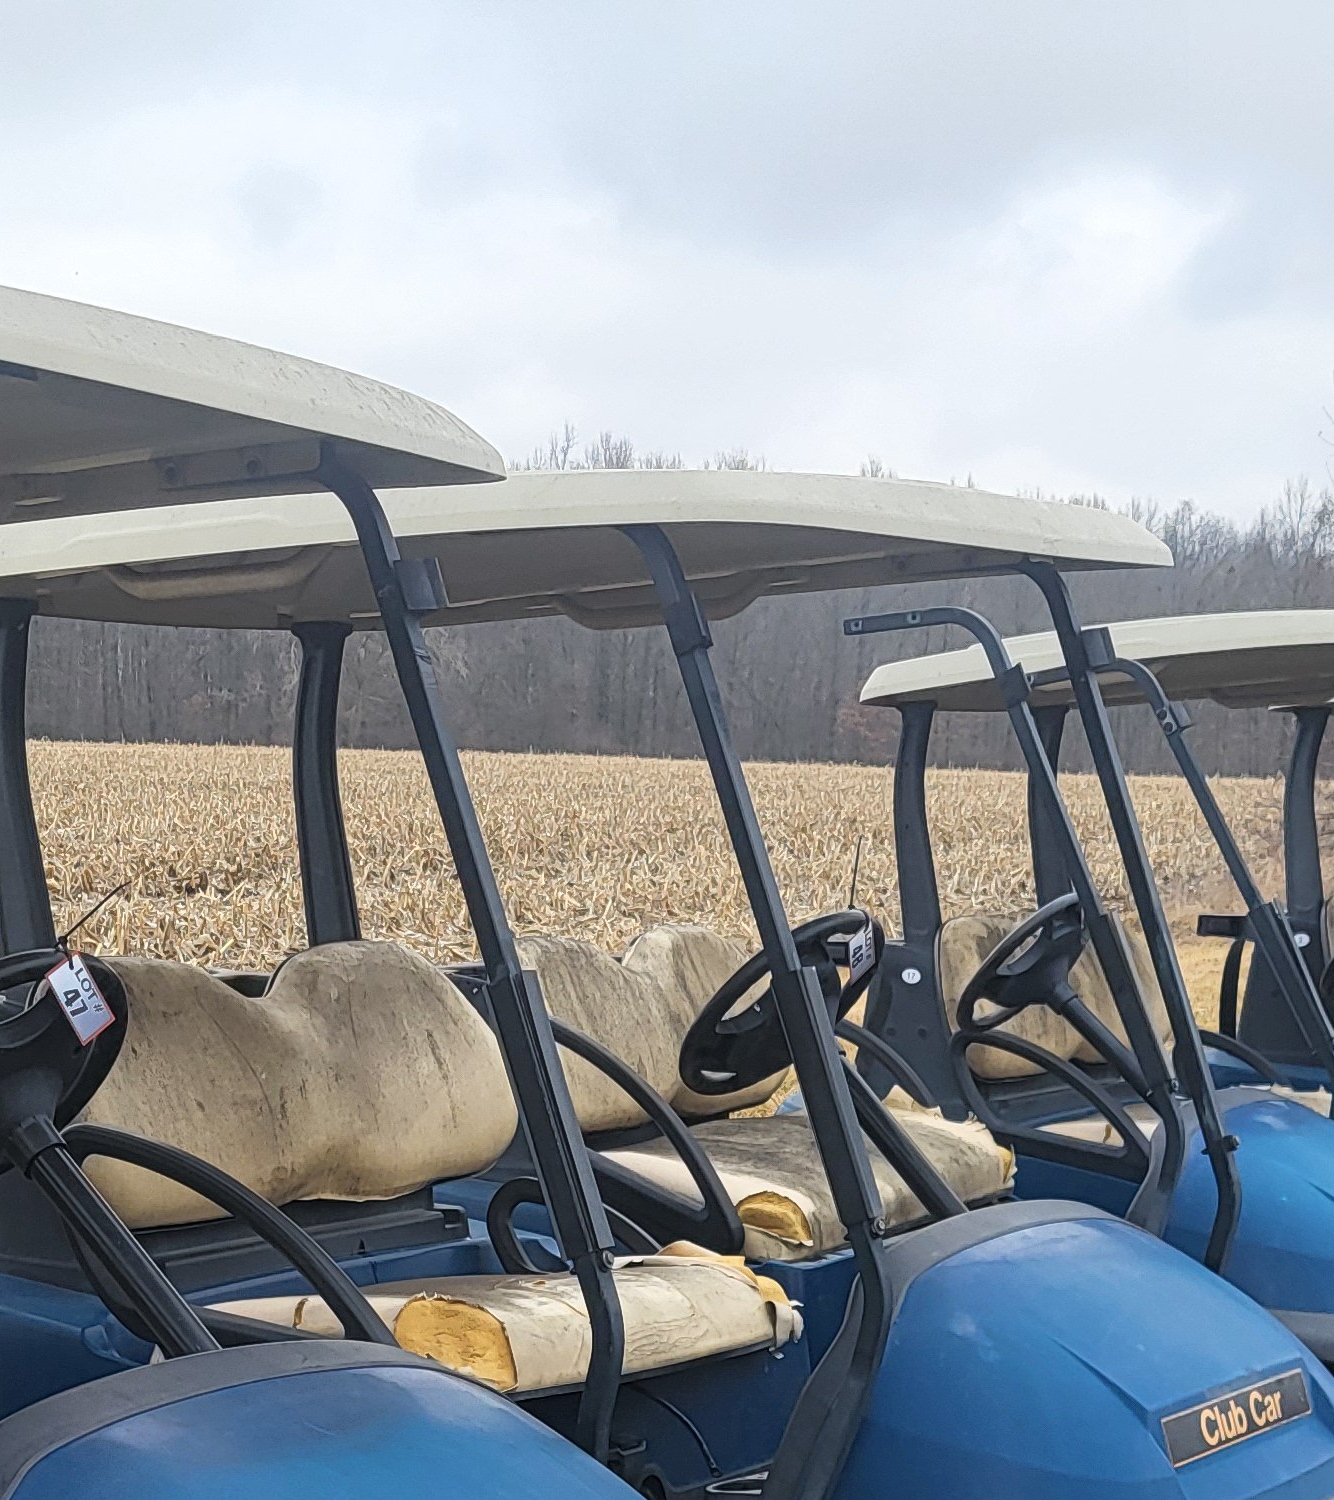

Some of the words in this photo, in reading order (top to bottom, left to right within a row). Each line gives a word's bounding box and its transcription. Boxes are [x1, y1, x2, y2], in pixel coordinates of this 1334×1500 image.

[851, 944, 864, 968] 48
[74, 967, 99, 1001] LOT
[63, 988, 88, 1017] 47
[1200, 1399, 1247, 1446] Club
[1249, 1391, 1282, 1427] Car
